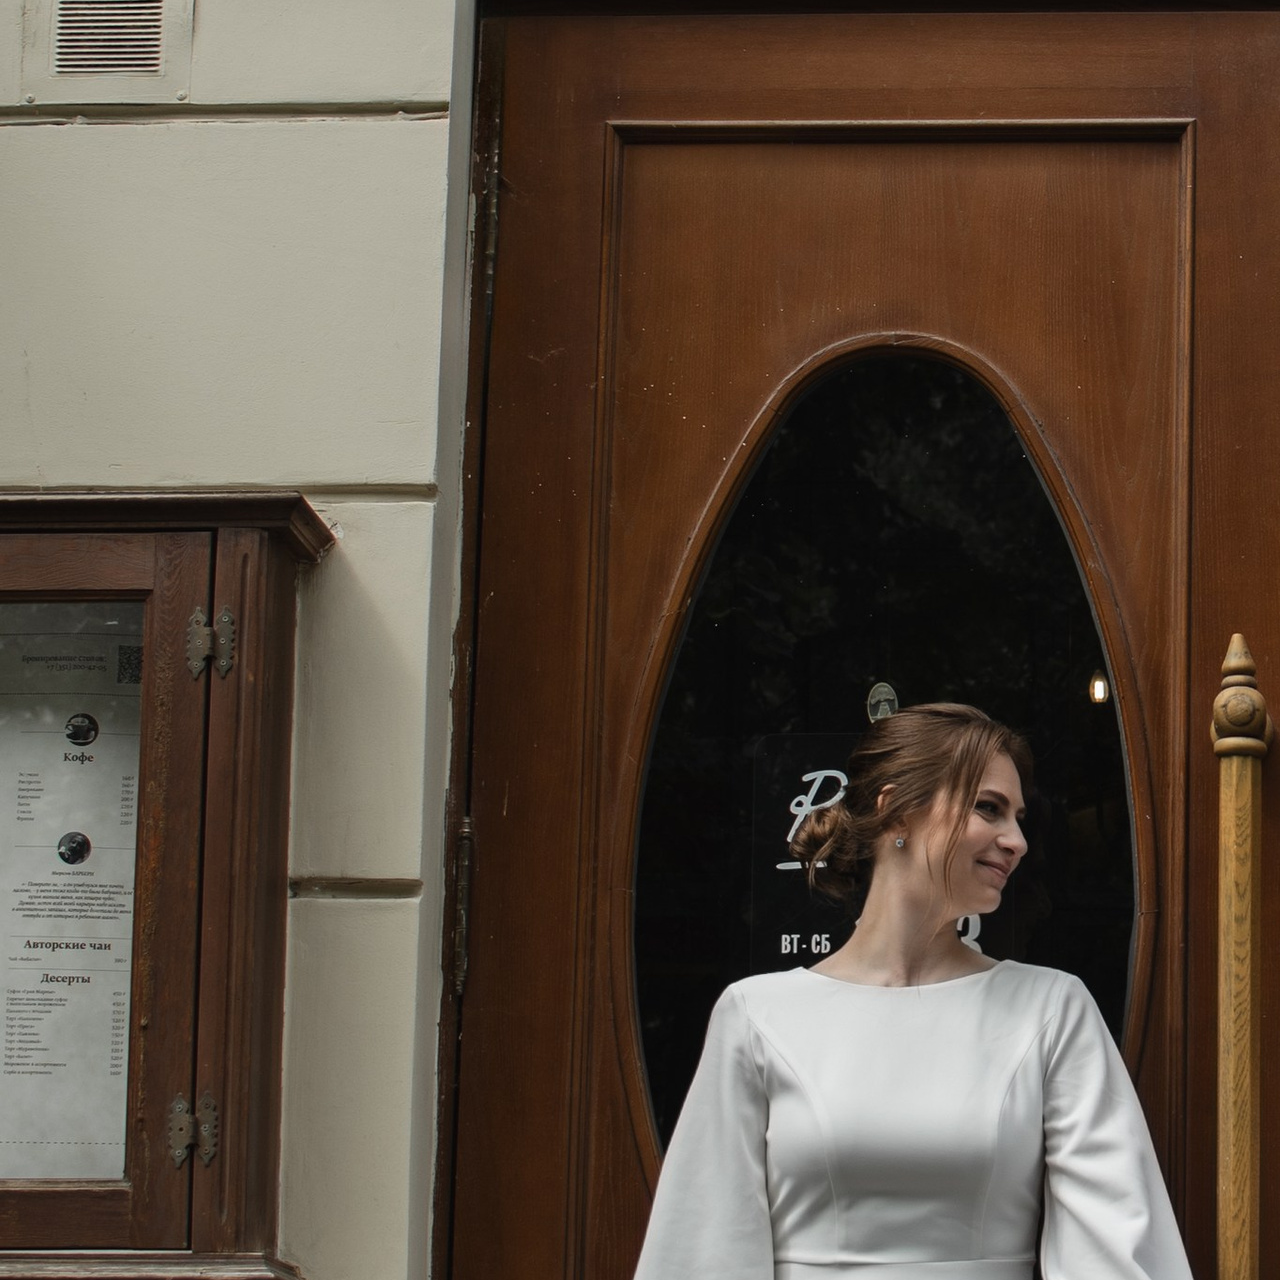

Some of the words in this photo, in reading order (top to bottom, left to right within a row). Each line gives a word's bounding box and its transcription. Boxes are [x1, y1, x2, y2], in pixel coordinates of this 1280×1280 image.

[63, 751, 94, 765] Кофе
[24, 939, 87, 952] Авторские
[89, 942, 112, 951] чаи
[40, 973, 91, 986] Десерты
